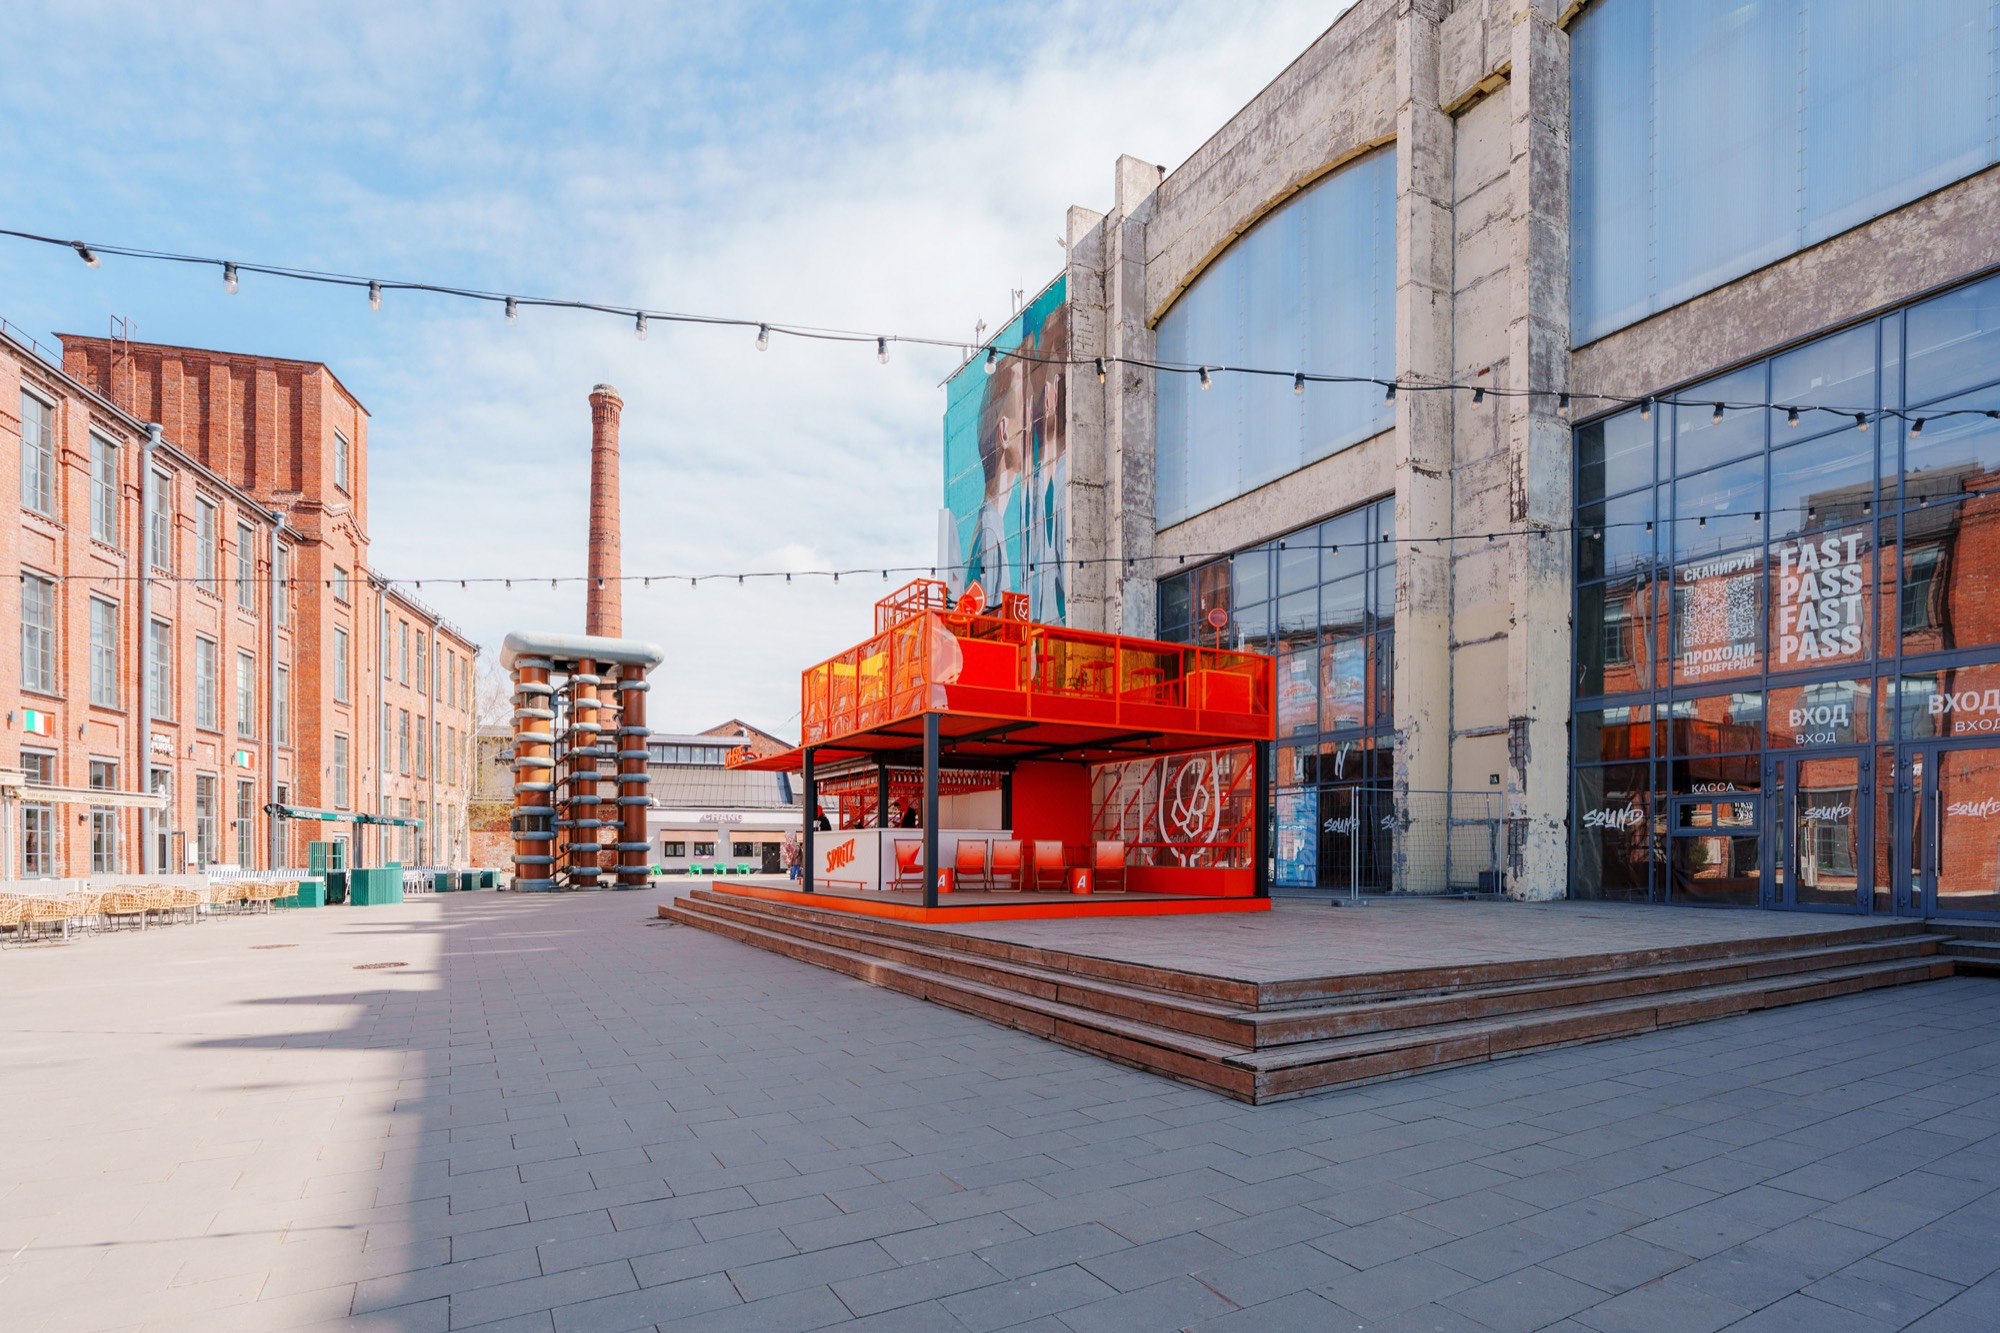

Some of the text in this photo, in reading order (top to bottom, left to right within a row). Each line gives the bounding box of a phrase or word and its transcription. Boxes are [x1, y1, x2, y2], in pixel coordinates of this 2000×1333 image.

[1683, 553, 1755, 582] СКАНИРУЙ
[1779, 532, 1863, 577] FAST
[1779, 564, 1863, 606] PASS
[1779, 593, 1863, 635] FAST
[1683, 642, 1756, 666] ПРОХОДИ
[1779, 625, 1863, 664] PASS
[1683, 665, 1701, 677] БЕЗ
[1788, 704, 1849, 728] ВХОД
[1928, 688, 2000, 716] ВХОД
[1795, 731, 1837, 745] ВХОД
[1691, 782, 1735, 793] КАССА
[1582, 801, 1644, 832] SOUND
[1804, 801, 1852, 822] SOUND
